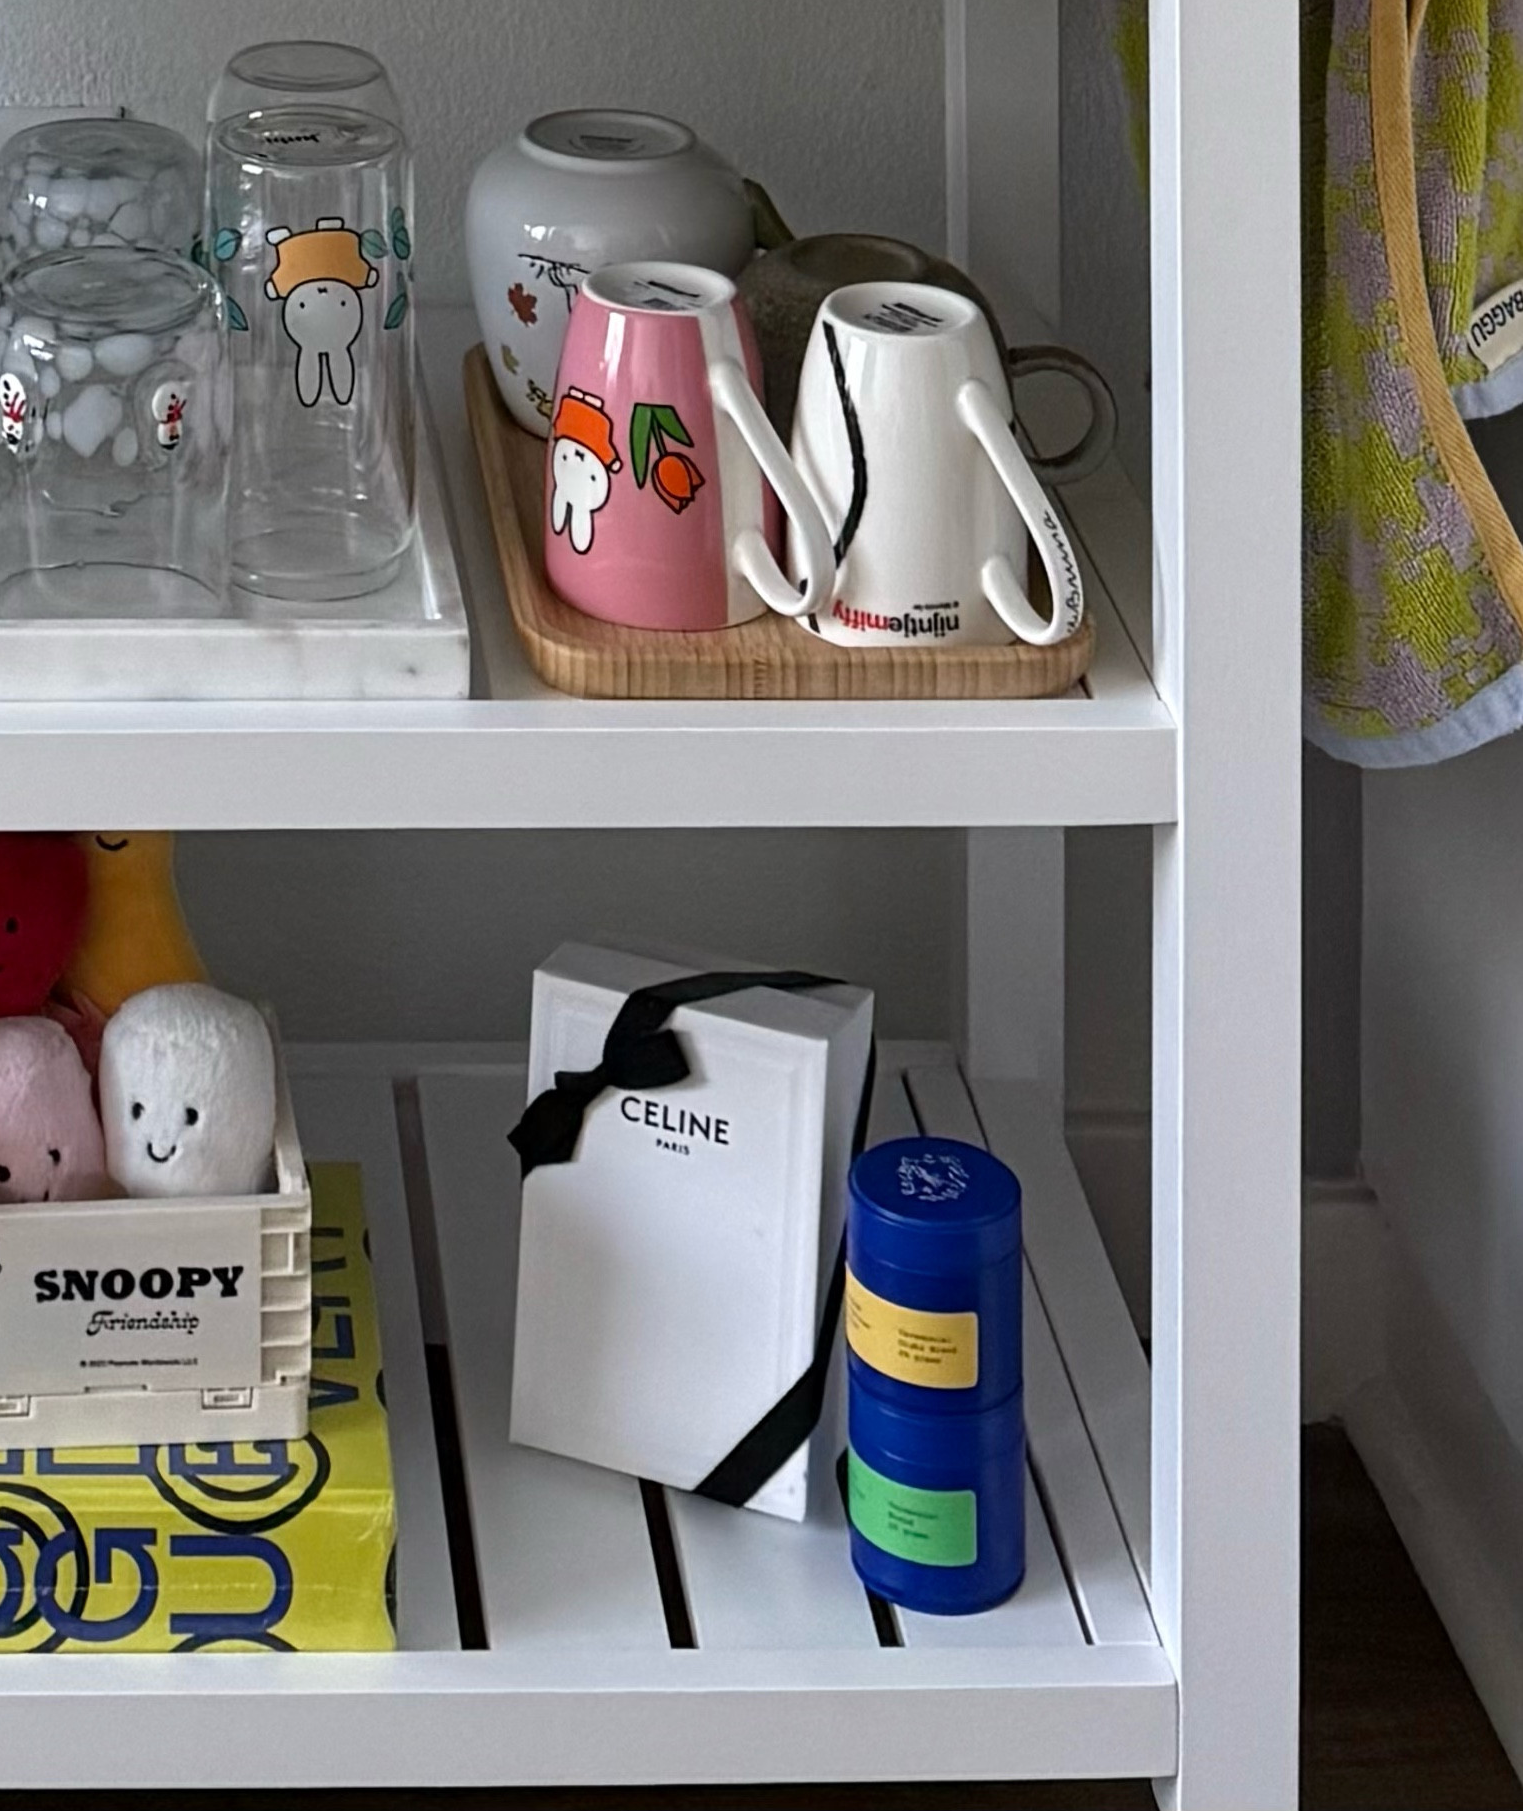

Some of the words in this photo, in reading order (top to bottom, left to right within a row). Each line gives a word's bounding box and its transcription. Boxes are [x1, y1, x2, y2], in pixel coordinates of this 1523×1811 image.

[1470, 289, 1523, 348] BAGGU
[620, 1095, 729, 1145] CELINE
[656, 1138, 690, 1156] PARIS
[33, 1266, 244, 1303] SNOOPY
[85, 1310, 200, 1336] Friendship
